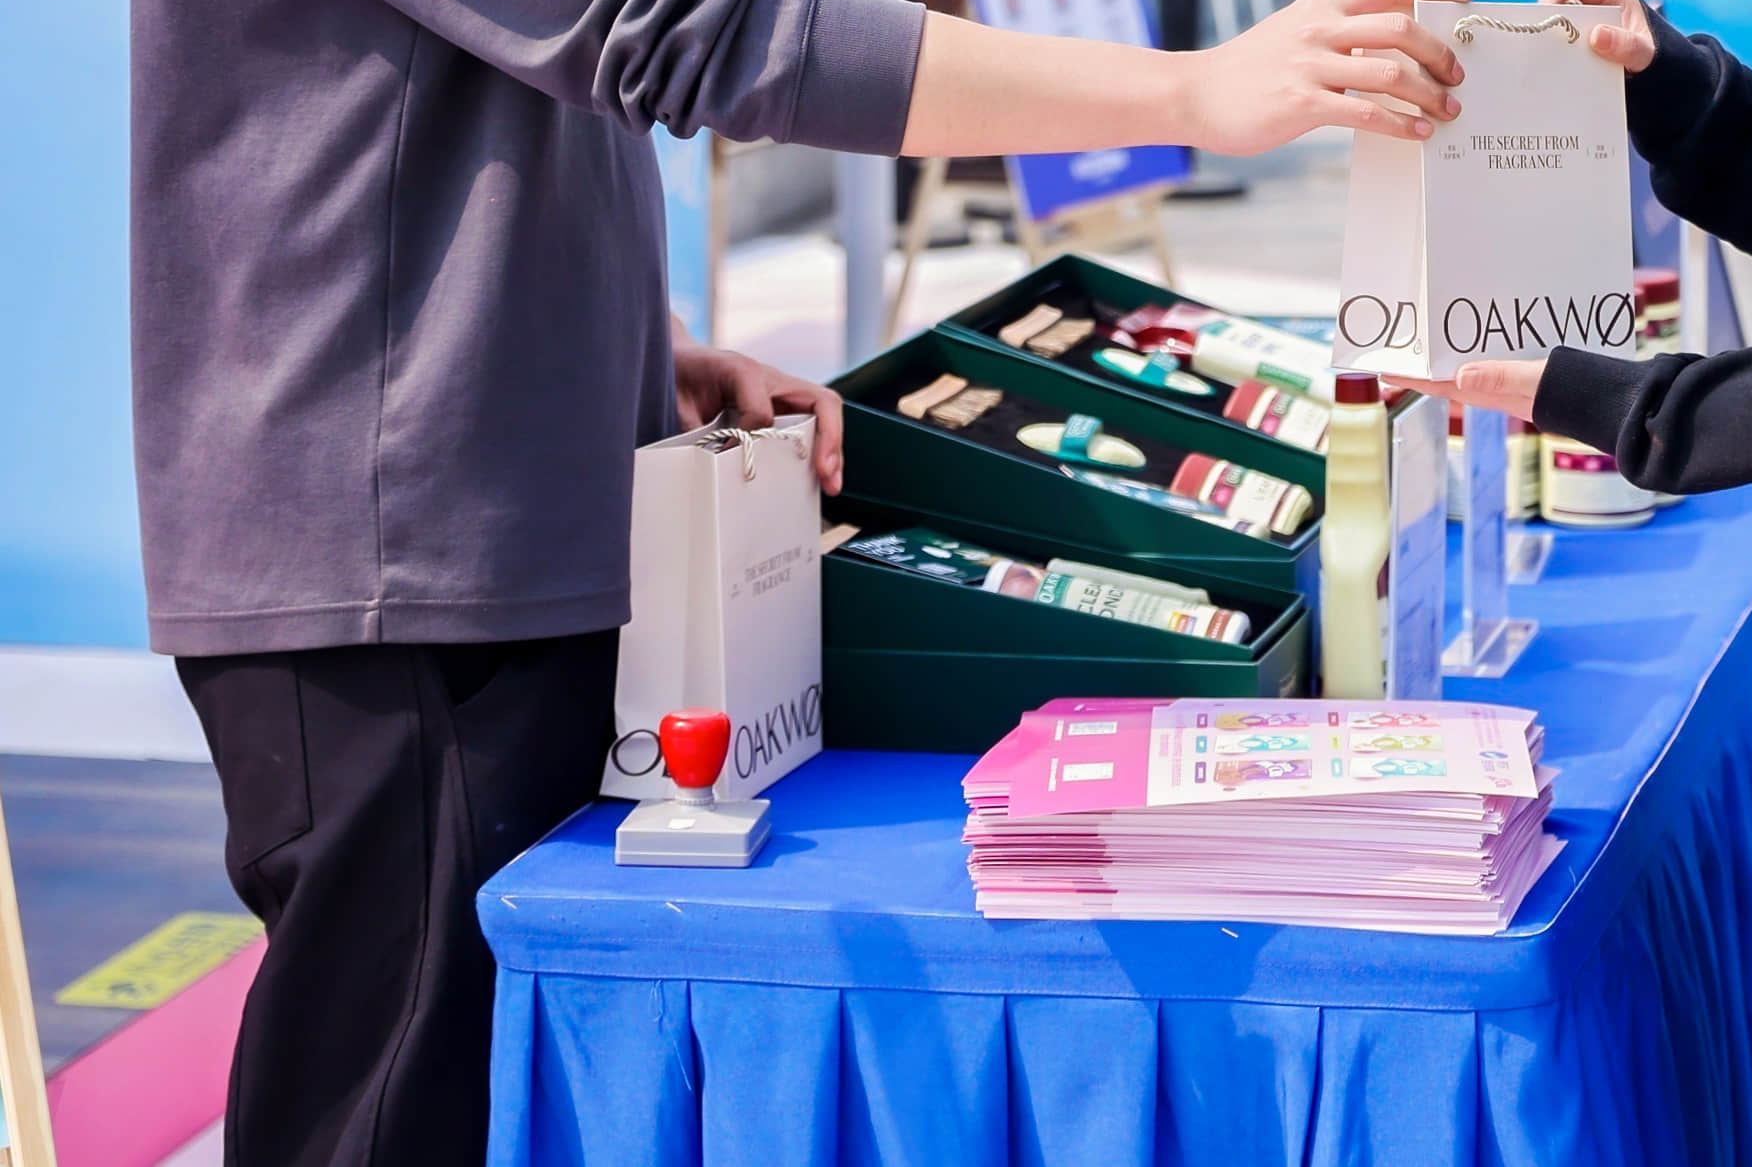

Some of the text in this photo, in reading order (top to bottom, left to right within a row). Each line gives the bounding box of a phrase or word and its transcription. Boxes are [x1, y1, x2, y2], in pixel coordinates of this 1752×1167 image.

[1470, 135, 1579, 151] THE SECRET FROM
[1487, 154, 1563, 169] FRAGRANCE
